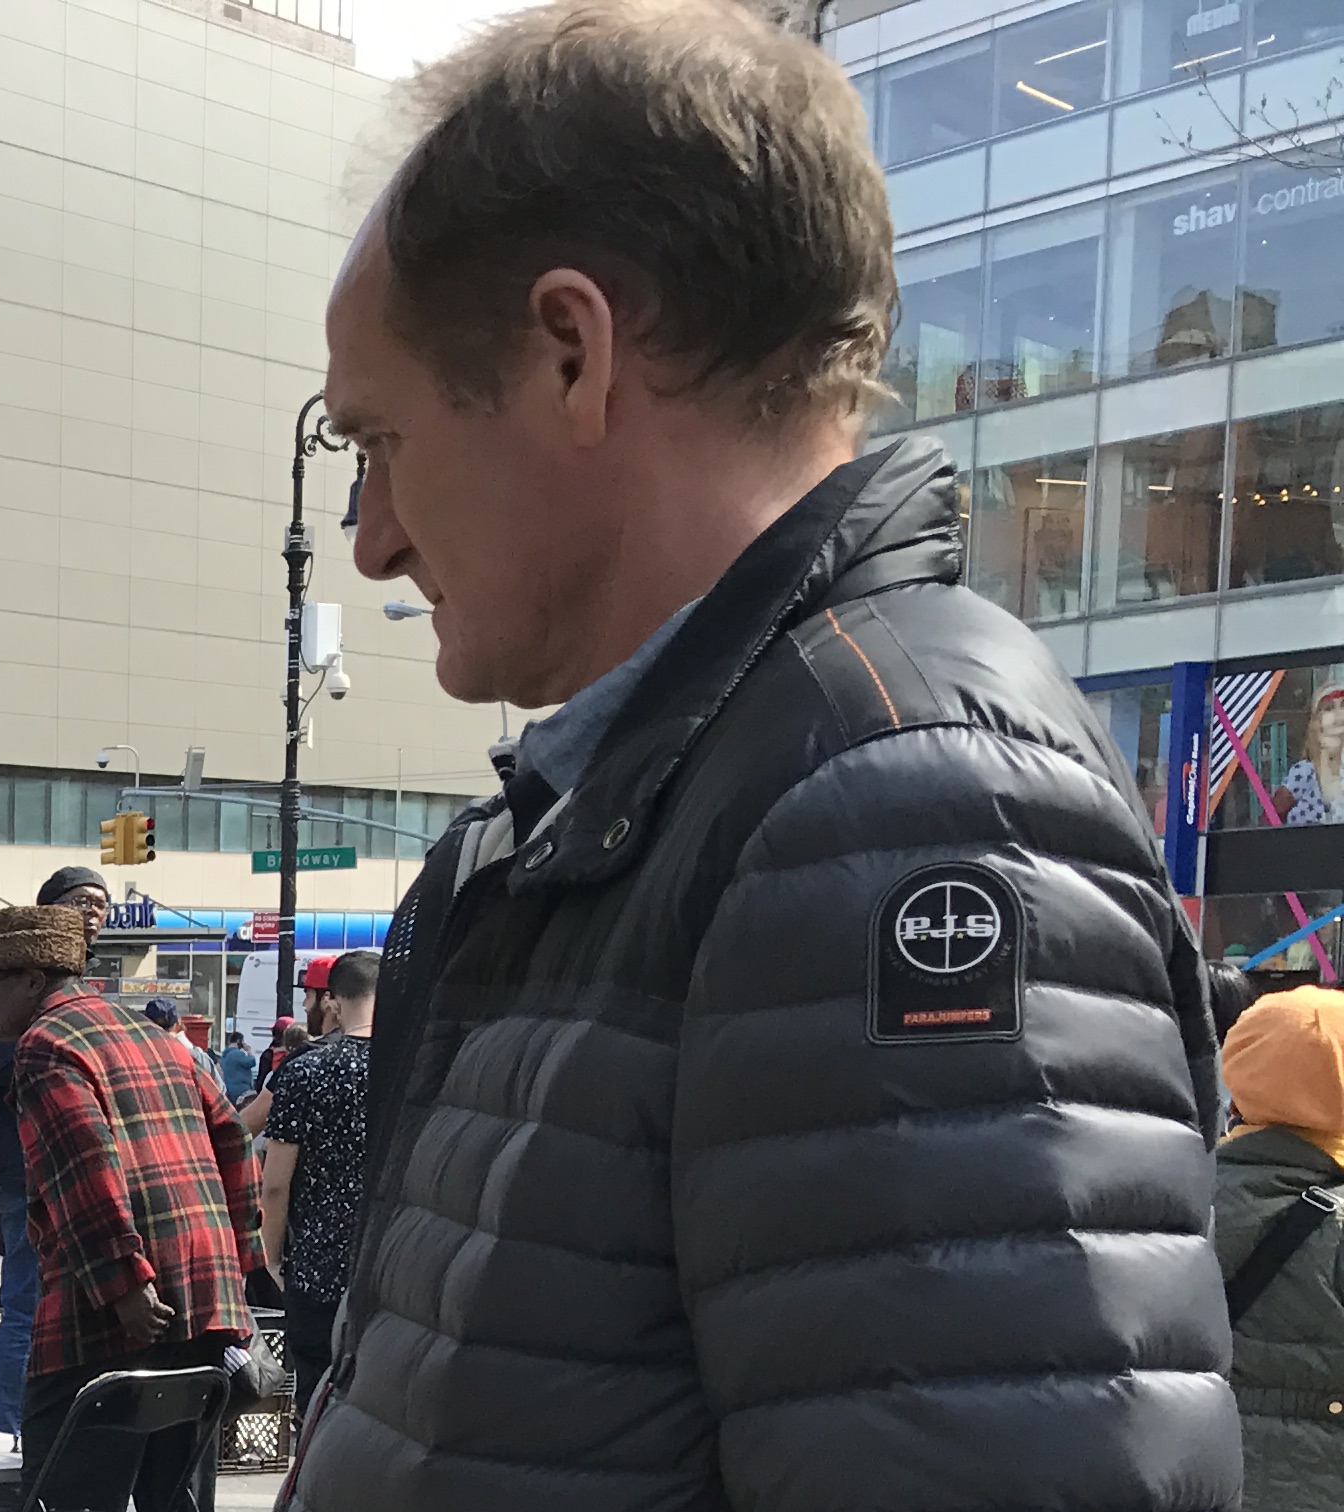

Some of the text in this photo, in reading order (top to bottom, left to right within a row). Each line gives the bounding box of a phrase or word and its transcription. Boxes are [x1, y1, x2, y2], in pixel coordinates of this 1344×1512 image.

[1257, 176, 1344, 215] contra
[267, 853, 340, 868] Badway
[104, 894, 157, 929] bank
